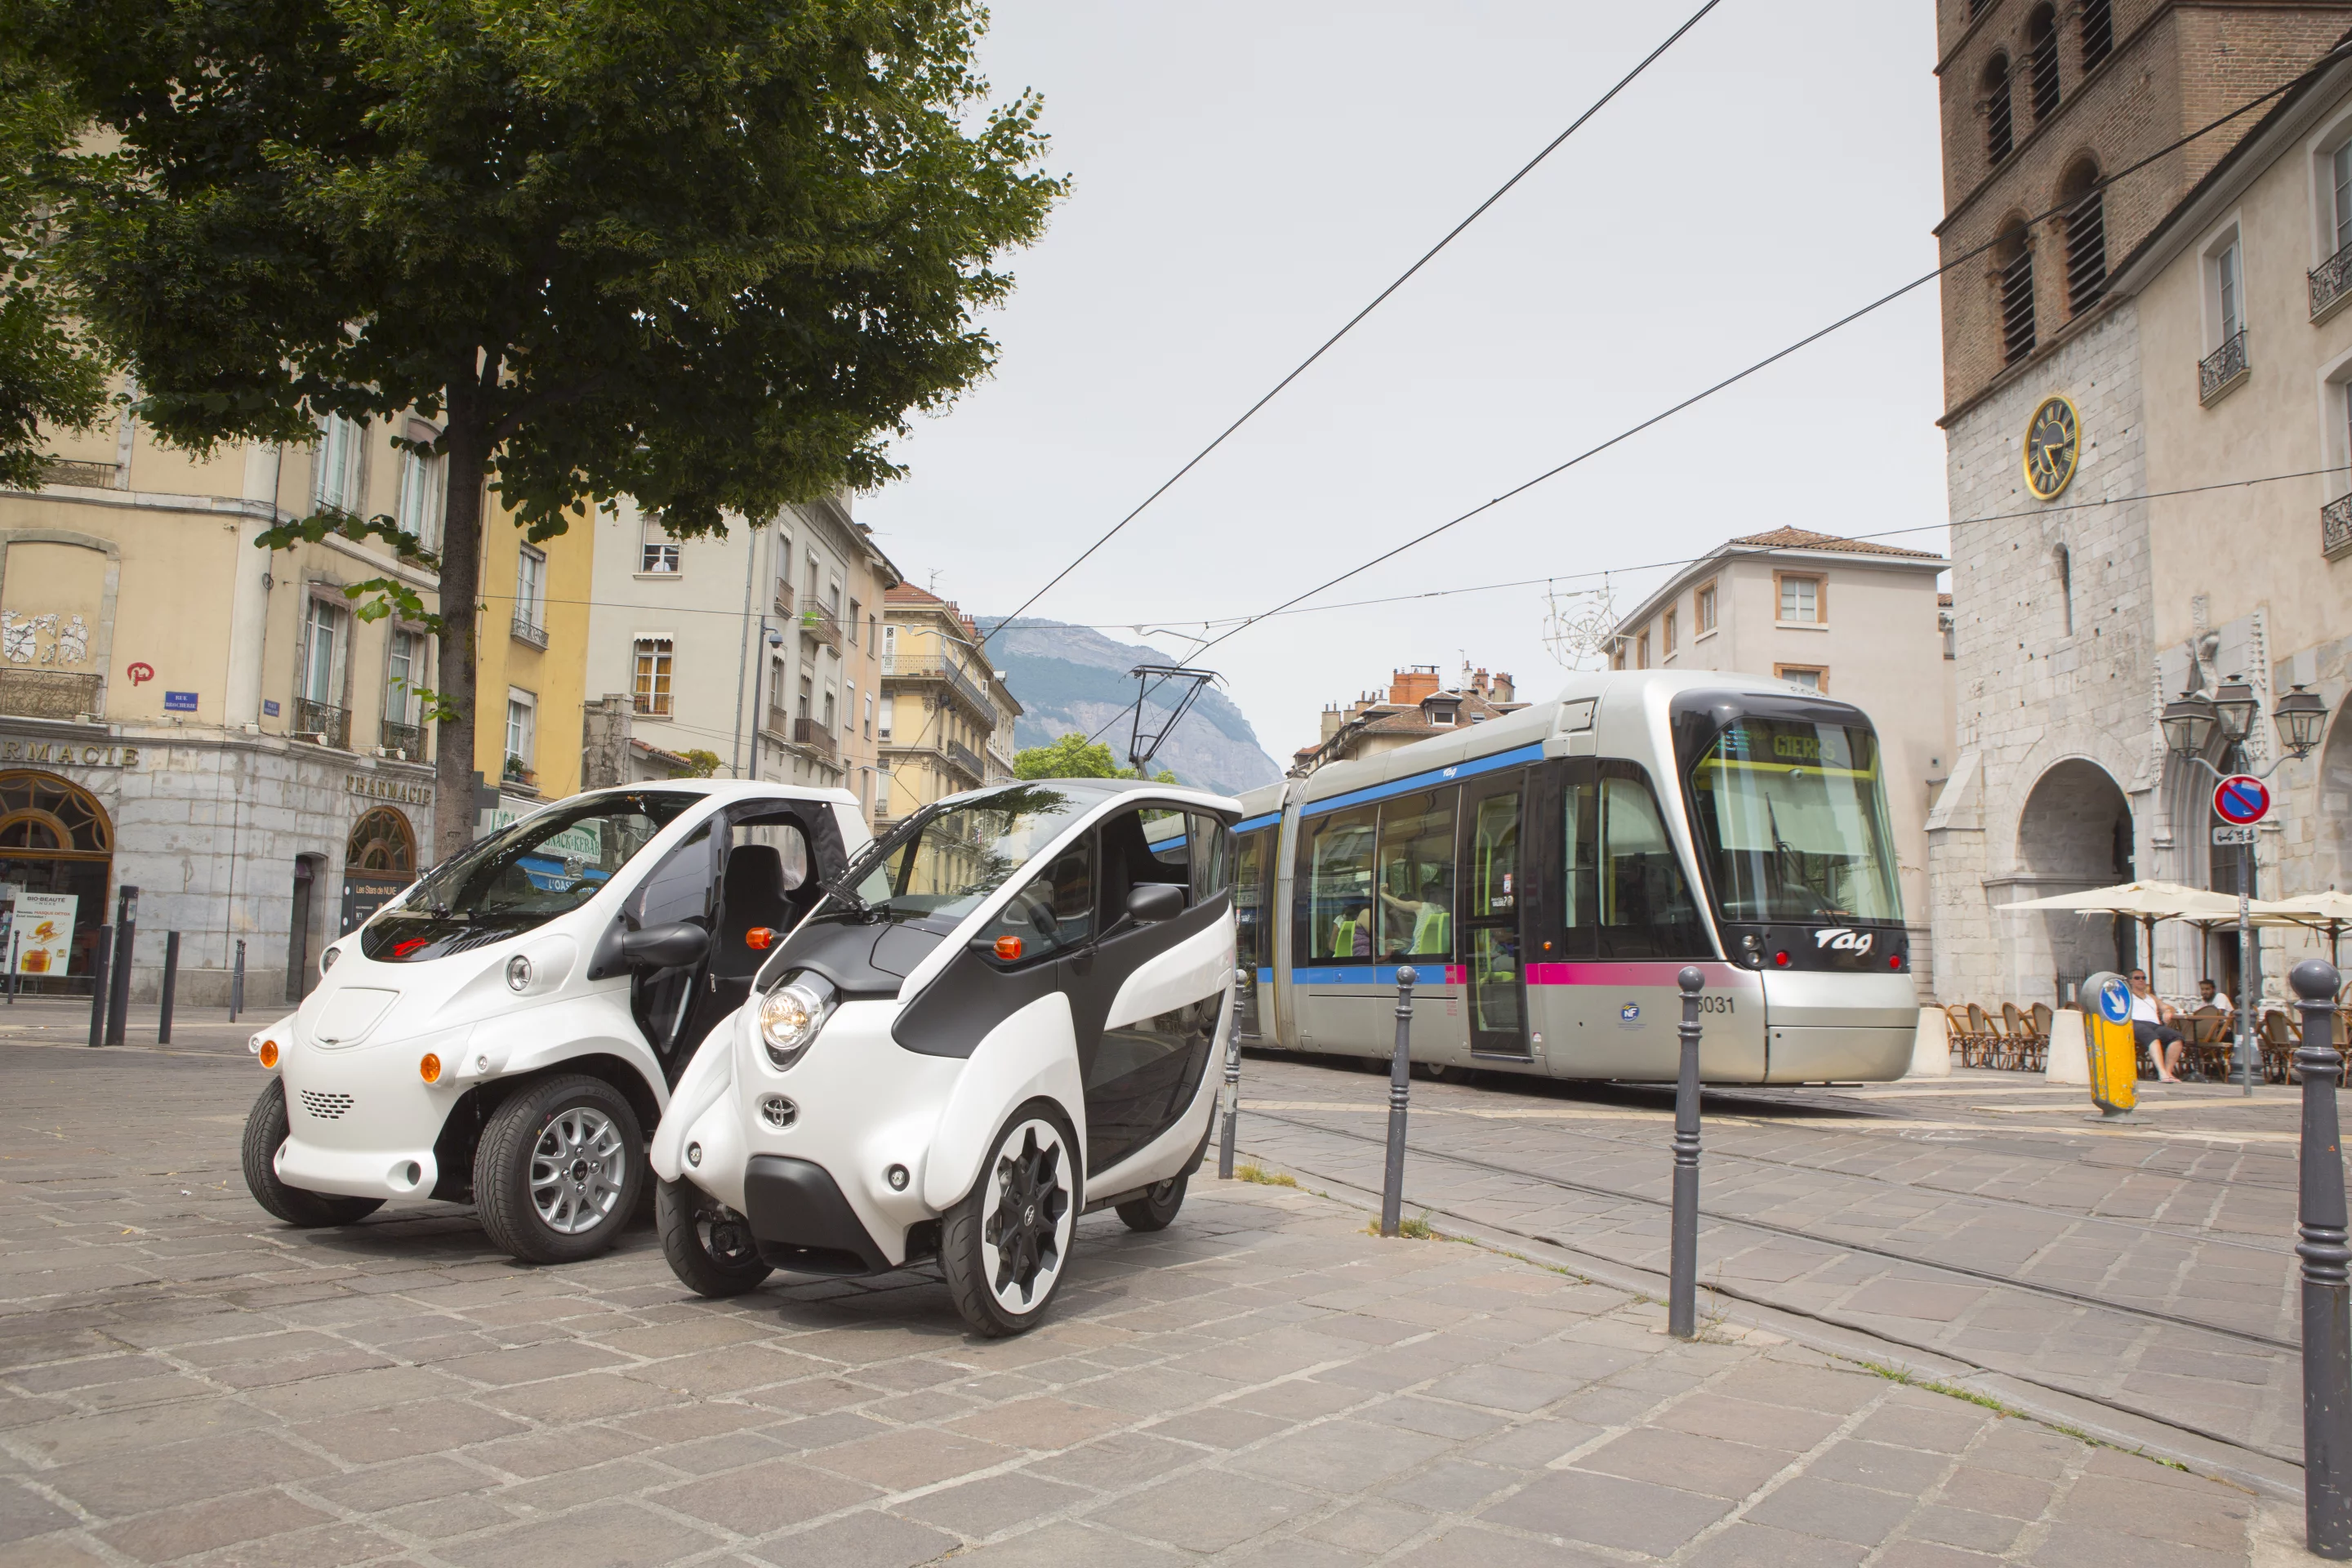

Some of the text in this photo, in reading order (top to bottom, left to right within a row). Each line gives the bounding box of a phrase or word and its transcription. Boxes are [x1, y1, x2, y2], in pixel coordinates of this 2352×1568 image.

[345, 774, 432, 804] PHARMACIE
[356, 884, 397, 896] Les Stars de NUXE
[1814, 929, 1873, 956] Tag
[1624, 1008, 1637, 1017] NF
